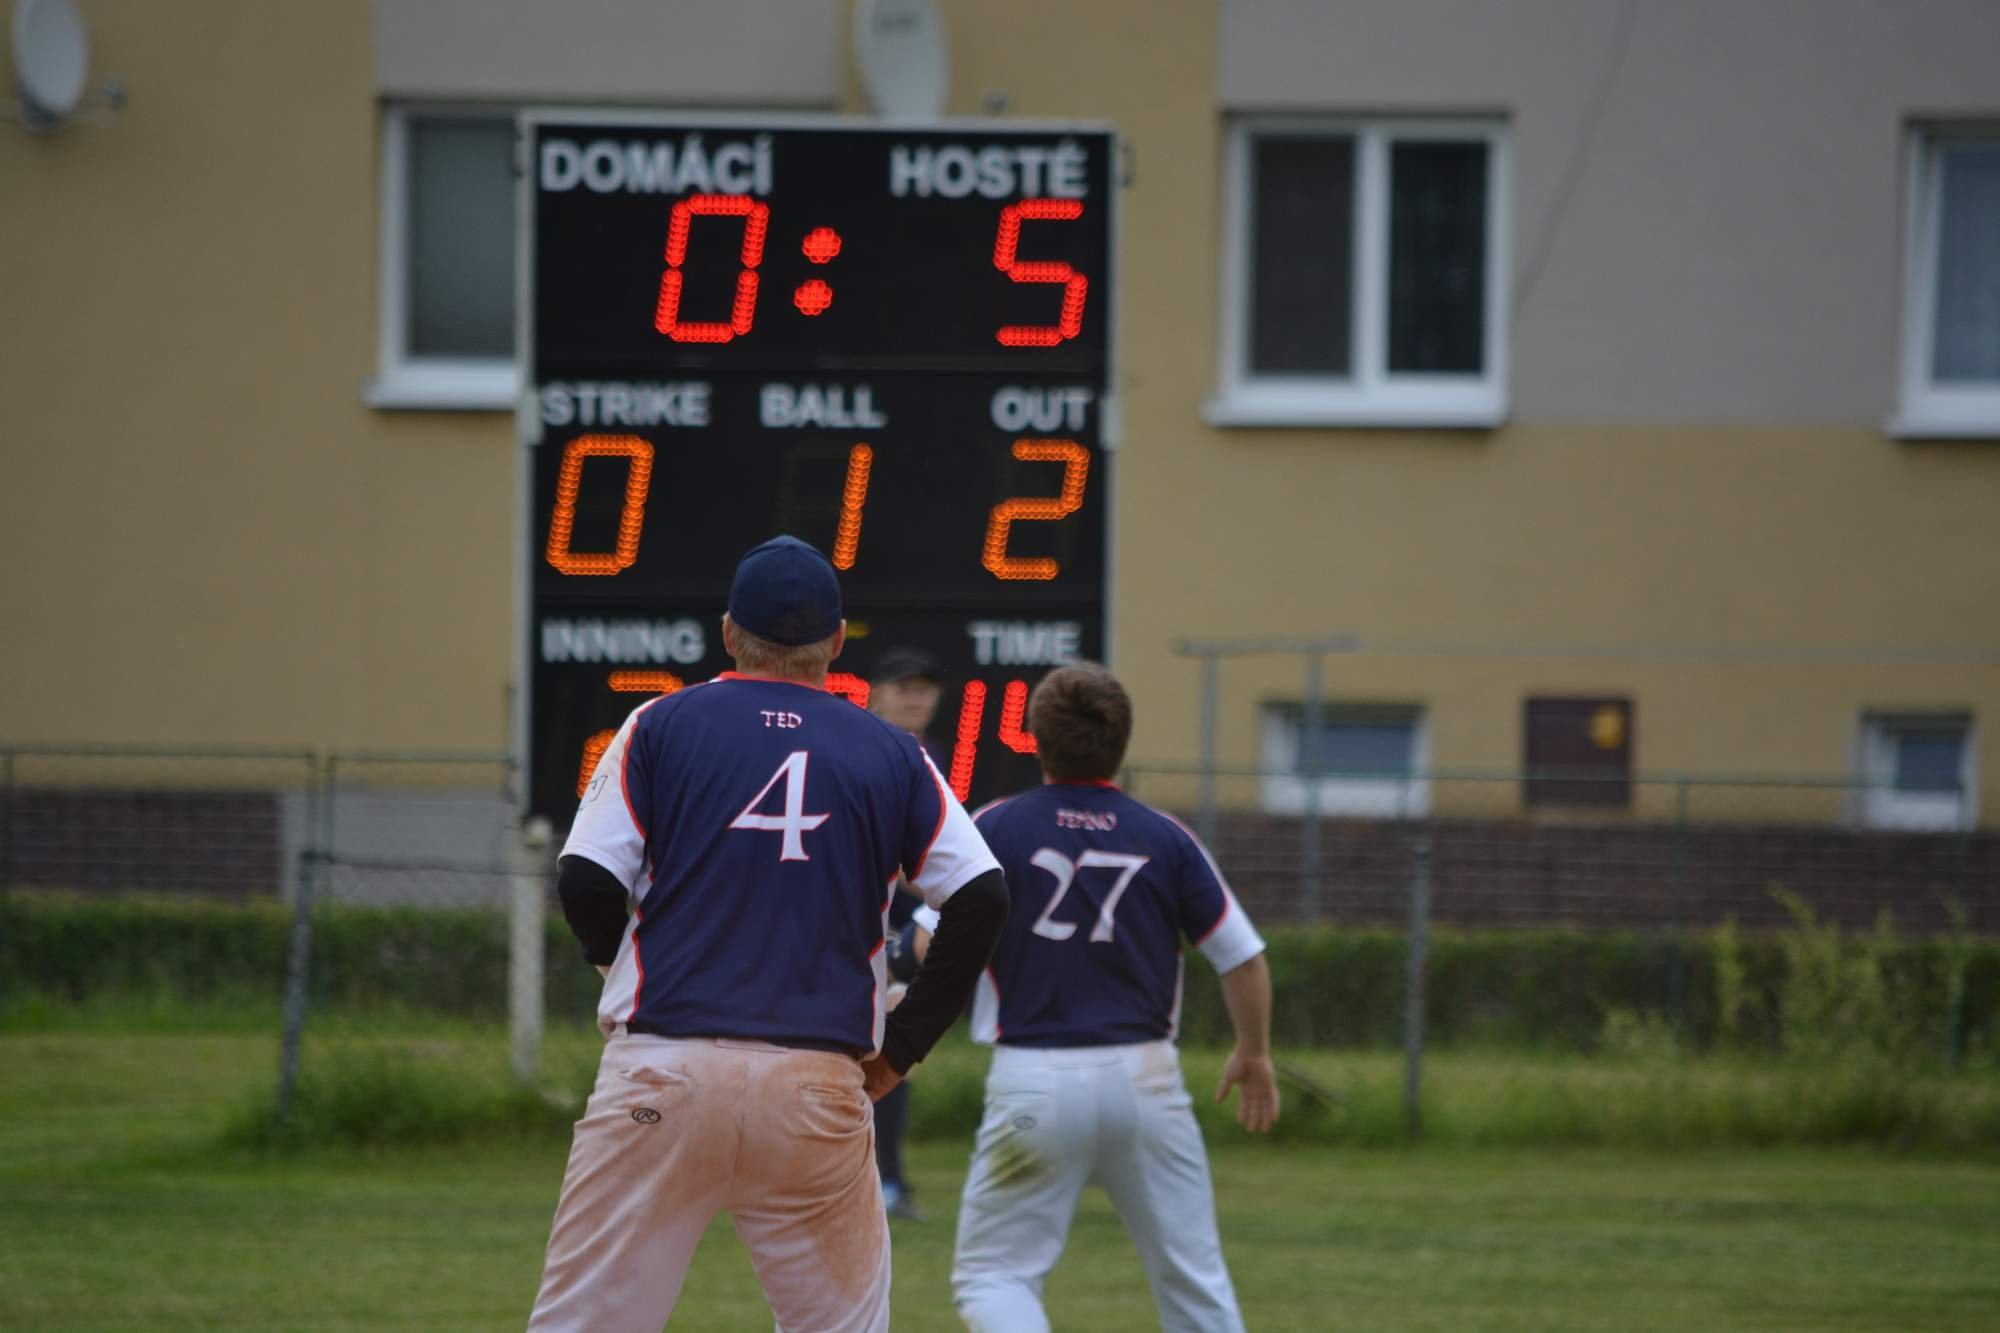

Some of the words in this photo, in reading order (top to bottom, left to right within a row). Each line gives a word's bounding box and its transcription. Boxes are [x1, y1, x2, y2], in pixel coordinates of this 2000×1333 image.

[541, 137, 773, 195] DOMÁCÍ
[890, 142, 1088, 198] HOSTÉ
[655, 193, 769, 343] 0
[993, 198, 1088, 346] 5
[541, 381, 710, 428] STRIKE
[760, 384, 886, 427] BALL
[991, 387, 1092, 431] OUT
[546, 434, 654, 575] 0
[833, 443, 872, 570] 1
[982, 439, 1089, 580] 2
[542, 620, 706, 664] INNING
[969, 621, 1082, 667] TIME
[760, 710, 802, 729] TED
[729, 750, 831, 862] 4
[1030, 847, 1149, 943] 27
